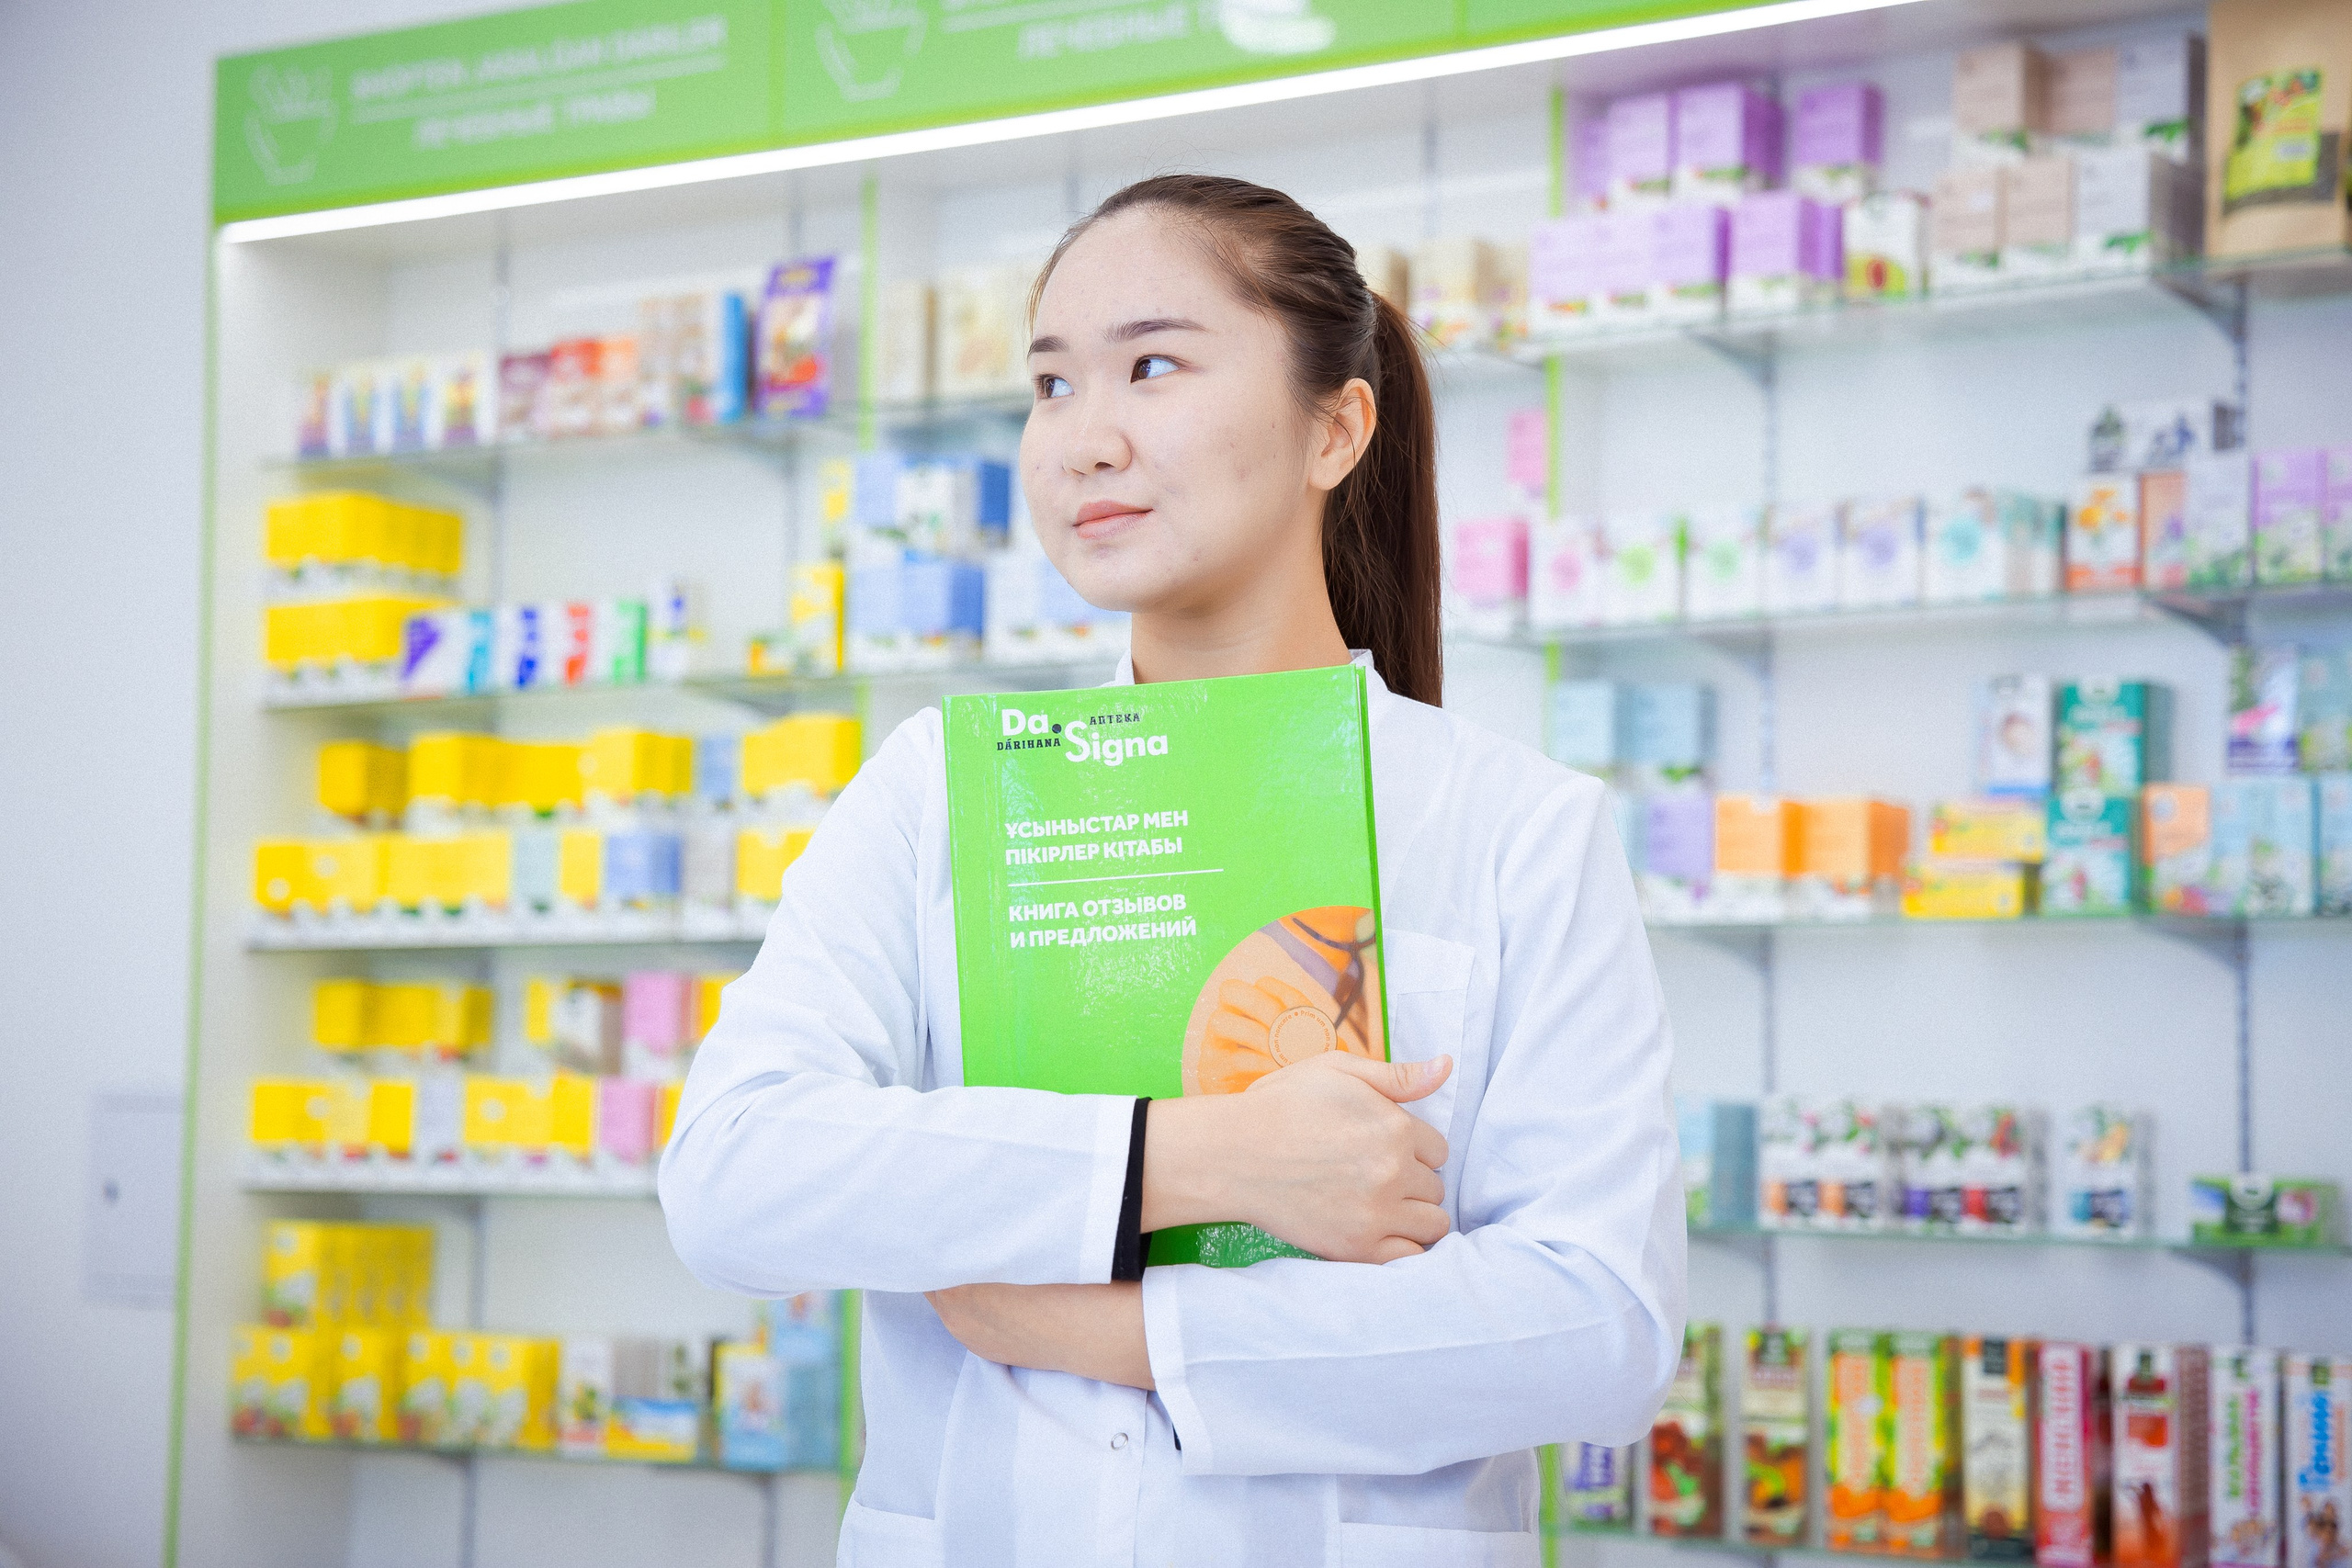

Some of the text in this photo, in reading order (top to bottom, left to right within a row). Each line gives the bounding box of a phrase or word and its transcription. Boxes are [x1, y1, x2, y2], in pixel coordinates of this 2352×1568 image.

[1090, 713, 1141, 726] АПТЕКА
[1064, 720, 1169, 767] Signa
[1004, 809, 1189, 840] ҰСЫНЫСТАР МЕН
[1005, 837, 1183, 866] ПІКІРЛЕР КІТАБЫ
[1009, 894, 1187, 922] КНИГА ОТЗЫВОВ
[1010, 916, 1197, 949] И ПРЕДЛОЖЕНИЙ
